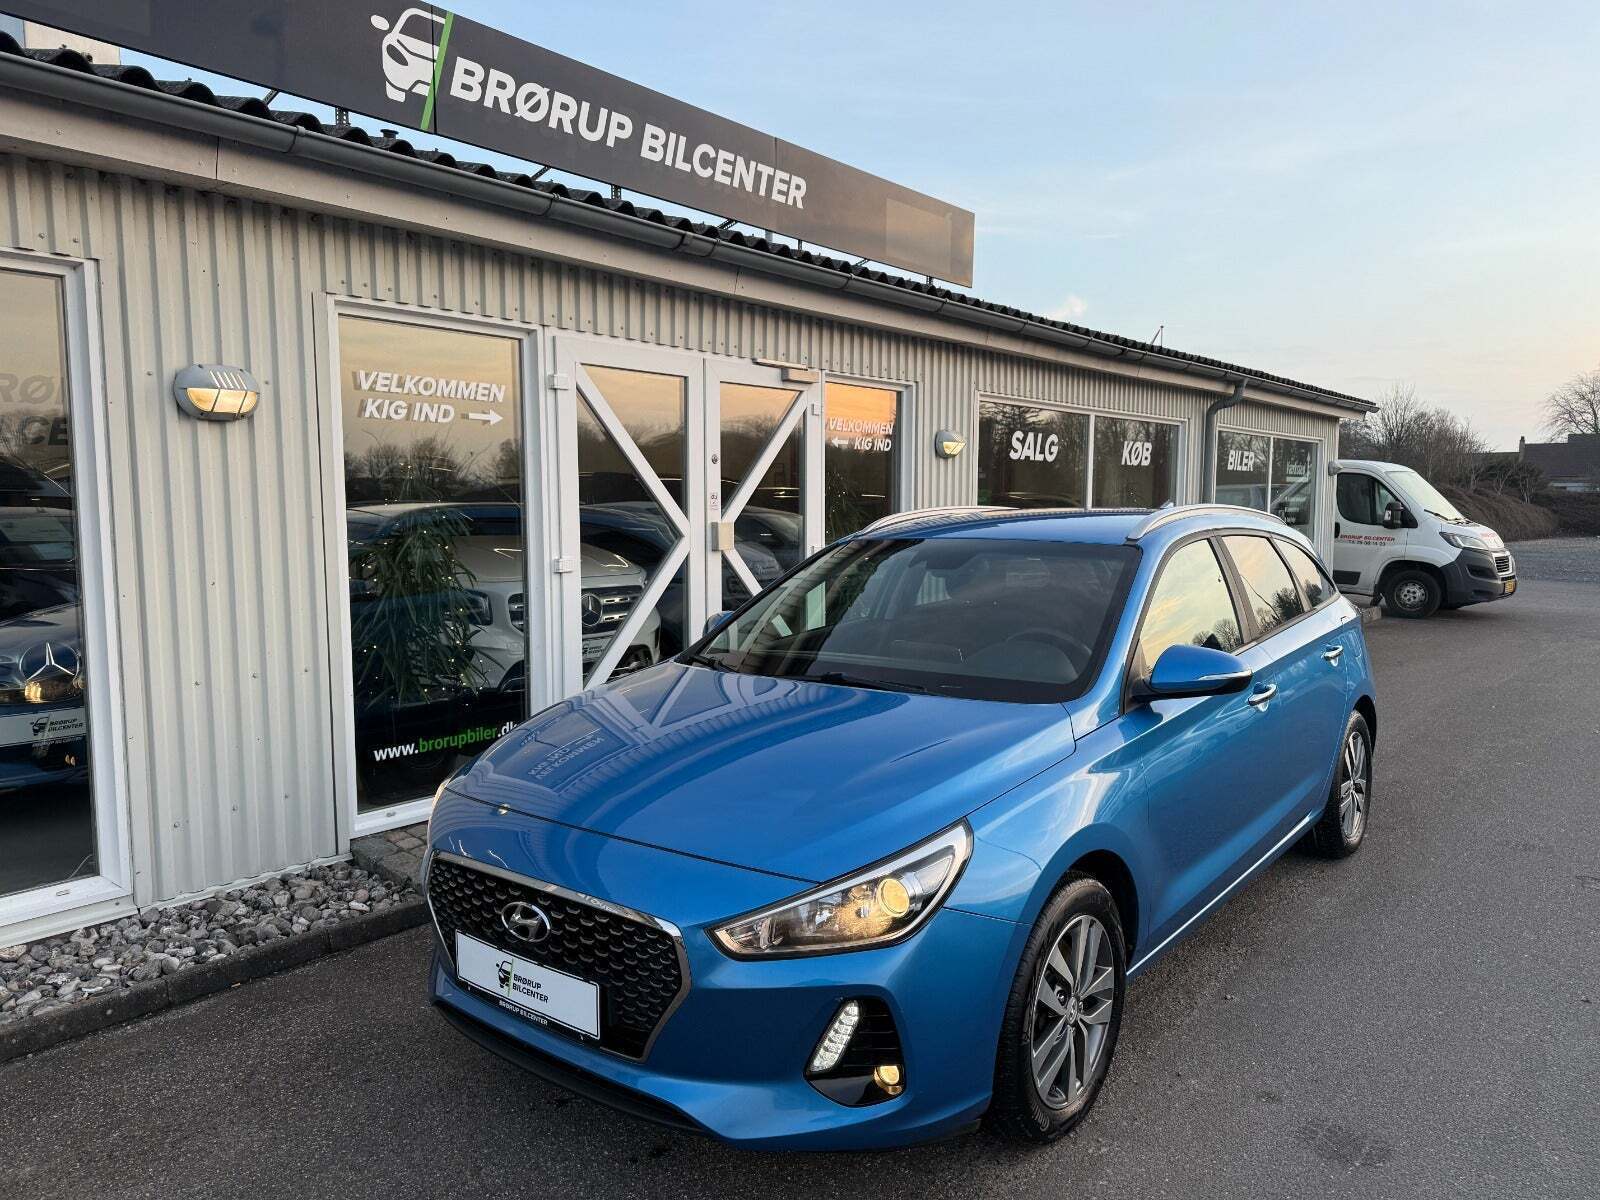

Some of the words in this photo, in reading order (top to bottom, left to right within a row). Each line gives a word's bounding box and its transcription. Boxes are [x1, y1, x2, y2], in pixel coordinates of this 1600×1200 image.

[450, 56, 633, 148] BRØRUP
[640, 124, 808, 209] BILCENTER
[358, 370, 506, 403] VELKOMMEN
[364, 398, 408, 420] KIG
[413, 402, 455, 423] IND
[829, 417, 894, 435] VELKOMMEN
[854, 436, 872, 451] KIG
[873, 438, 892, 452] IND
[1009, 430, 1059, 462] SALG
[1121, 441, 1153, 466] KØB
[1227, 450, 1255, 471] BILER
[513, 974, 542, 990] BRØRUP
[512, 983, 549, 1003] BILCENTER
[520, 1010, 548, 1025] BILCENTER
